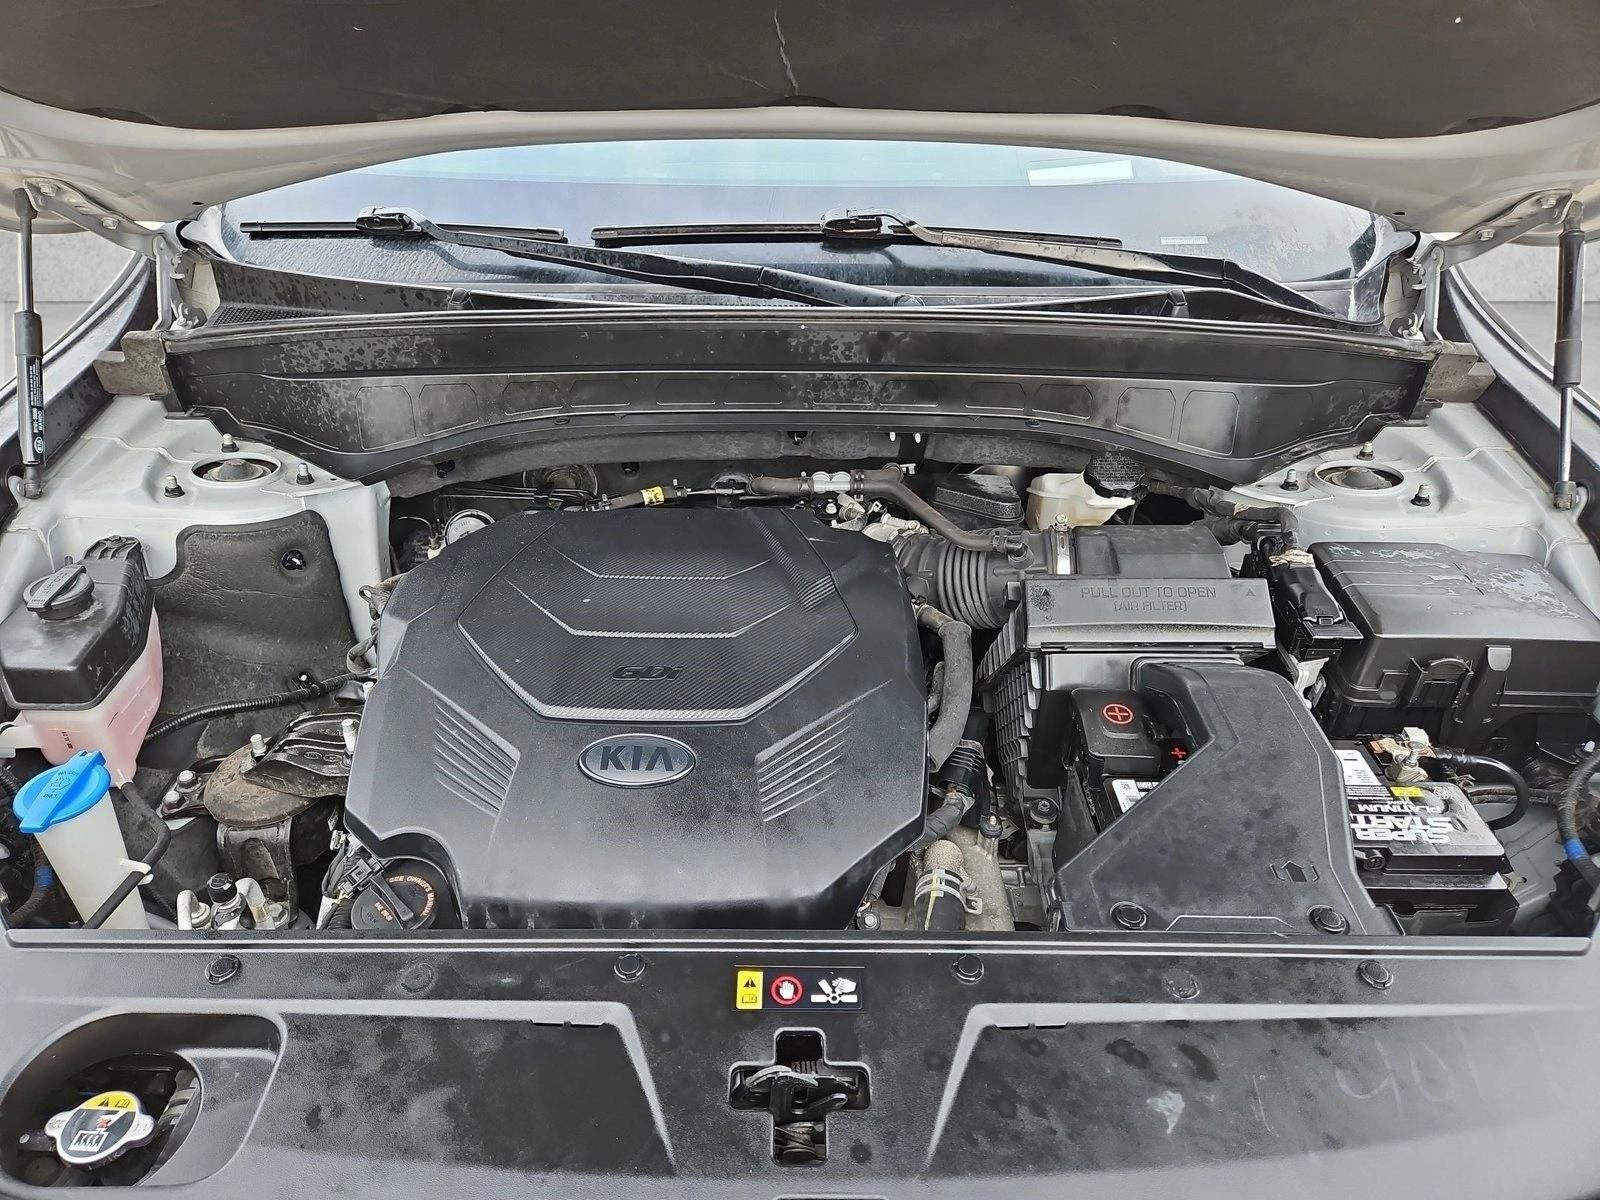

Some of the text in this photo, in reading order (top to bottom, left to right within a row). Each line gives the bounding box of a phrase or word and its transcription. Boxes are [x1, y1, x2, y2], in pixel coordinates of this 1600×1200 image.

[1080, 586, 1217, 599] PULL OUT TO OPEN
[600, 745, 674, 772] KIA
[1356, 803, 1441, 814] PLATINUM
[1349, 814, 1456, 833] START
[1354, 828, 1451, 843] SUPER
[388, 875, 405, 883] SEE
[420, 892, 435, 917] MANUAL
